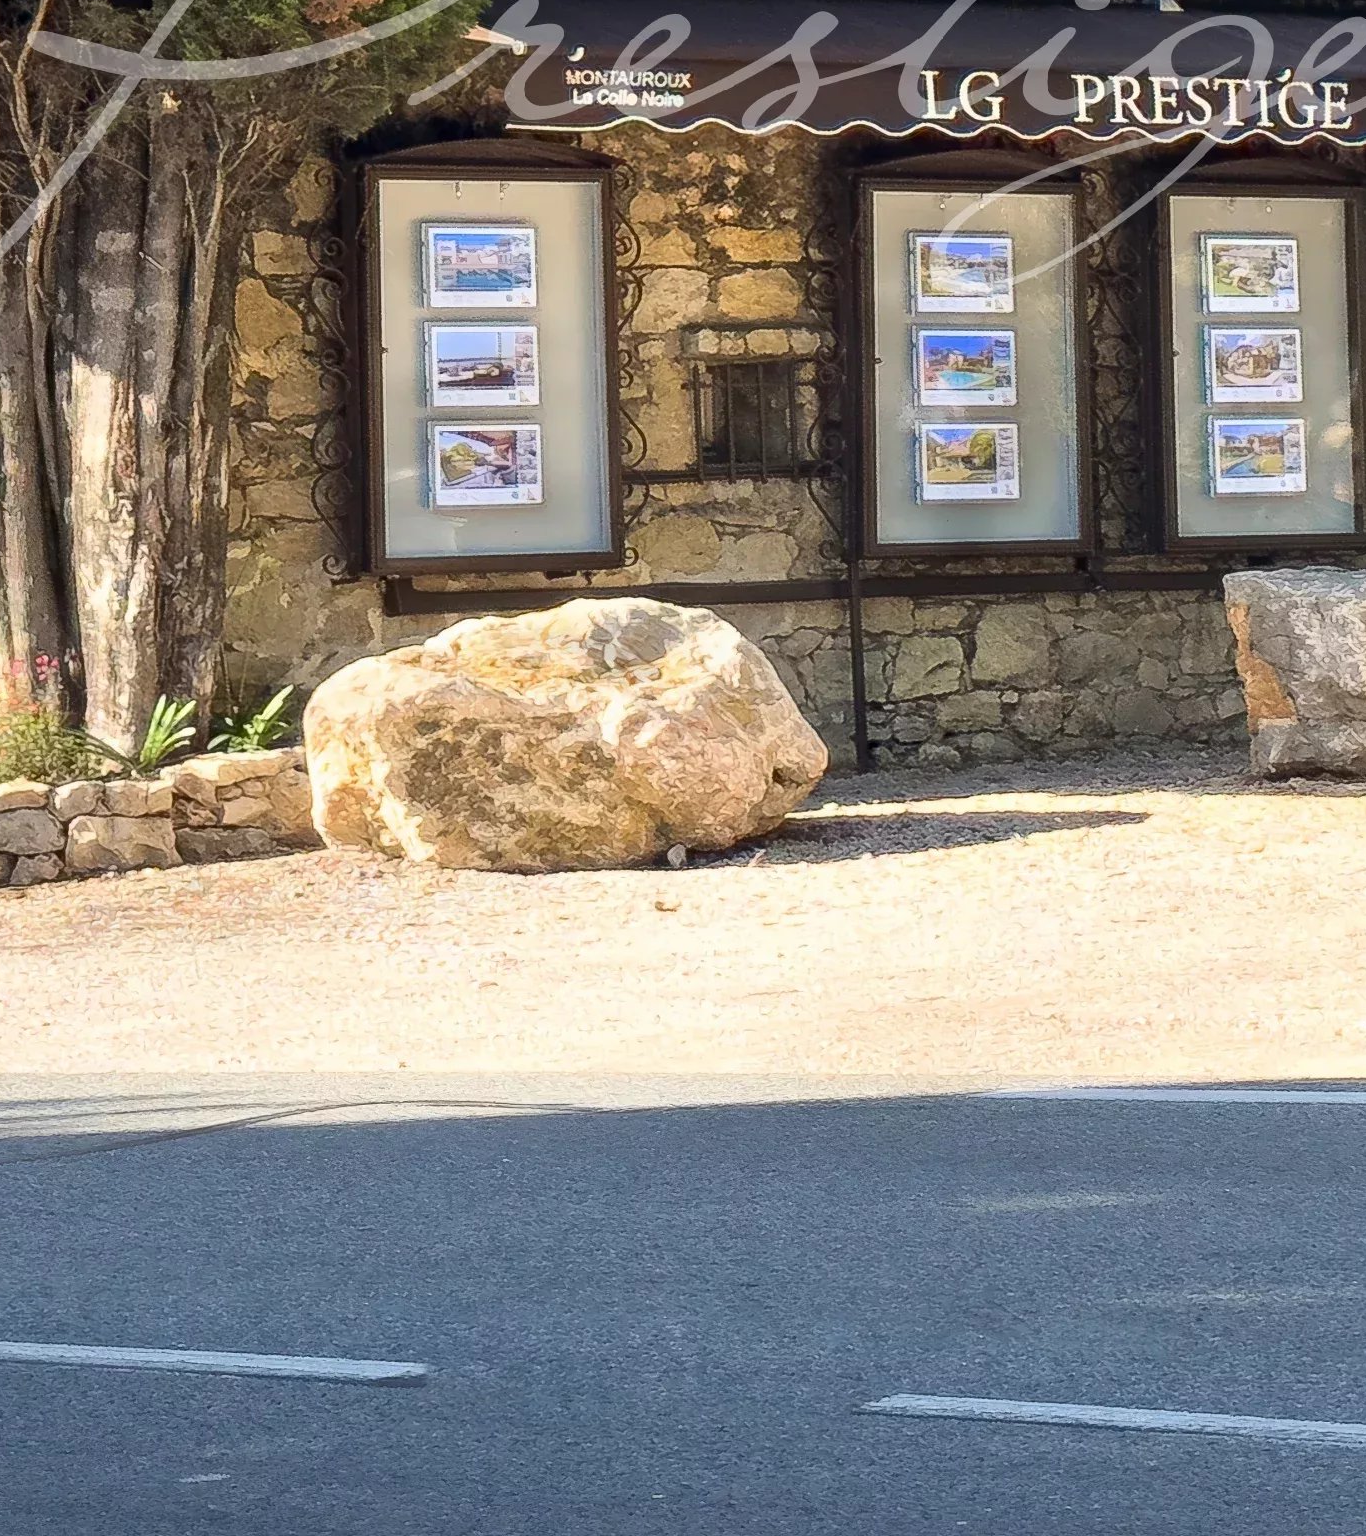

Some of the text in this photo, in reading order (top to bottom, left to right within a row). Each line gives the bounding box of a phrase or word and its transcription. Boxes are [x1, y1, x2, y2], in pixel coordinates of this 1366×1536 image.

[565, 69, 693, 89] MONTAUROUX
[573, 88, 685, 108] La Colle Noire
[919, 70, 1005, 123] LG
[1071, 72, 1353, 130] PRESTIGE
